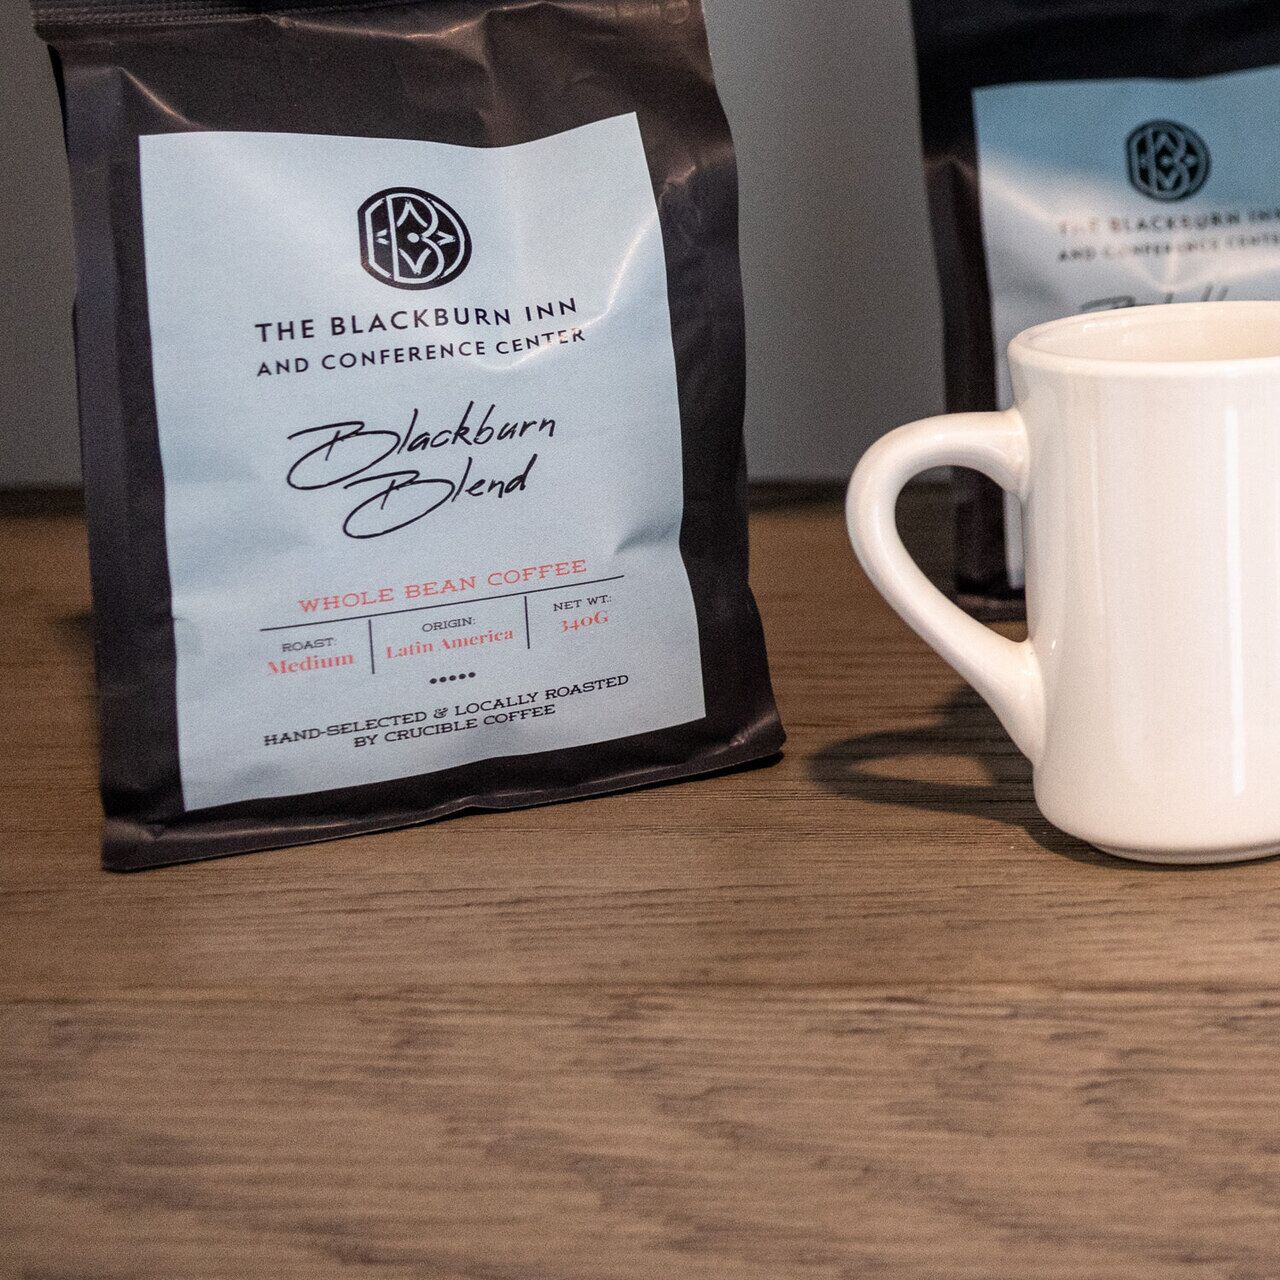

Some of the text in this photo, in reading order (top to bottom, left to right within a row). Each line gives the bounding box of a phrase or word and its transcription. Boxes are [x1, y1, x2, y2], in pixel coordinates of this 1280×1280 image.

[255, 298, 576, 342] THE BLACKBURN INN
[257, 330, 585, 376] AND CONFERENCE CENTER
[286, 401, 556, 490] Blackburn
[342, 454, 537, 539] Blend
[298, 560, 586, 612] WHOLE BEAN COFFEE
[553, 599, 582, 611] NET
[422, 618, 476, 632] ORIGIN:
[563, 612, 608, 631] 340G
[268, 655, 353, 673] Medium
[282, 639, 336, 652] ROAST:
[387, 630, 513, 658] Latin America
[264, 675, 629, 746] HAND-SELECTED & LOCALLY ROASTED
[354, 699, 555, 747] BY CRUCIBLE COFFEE
